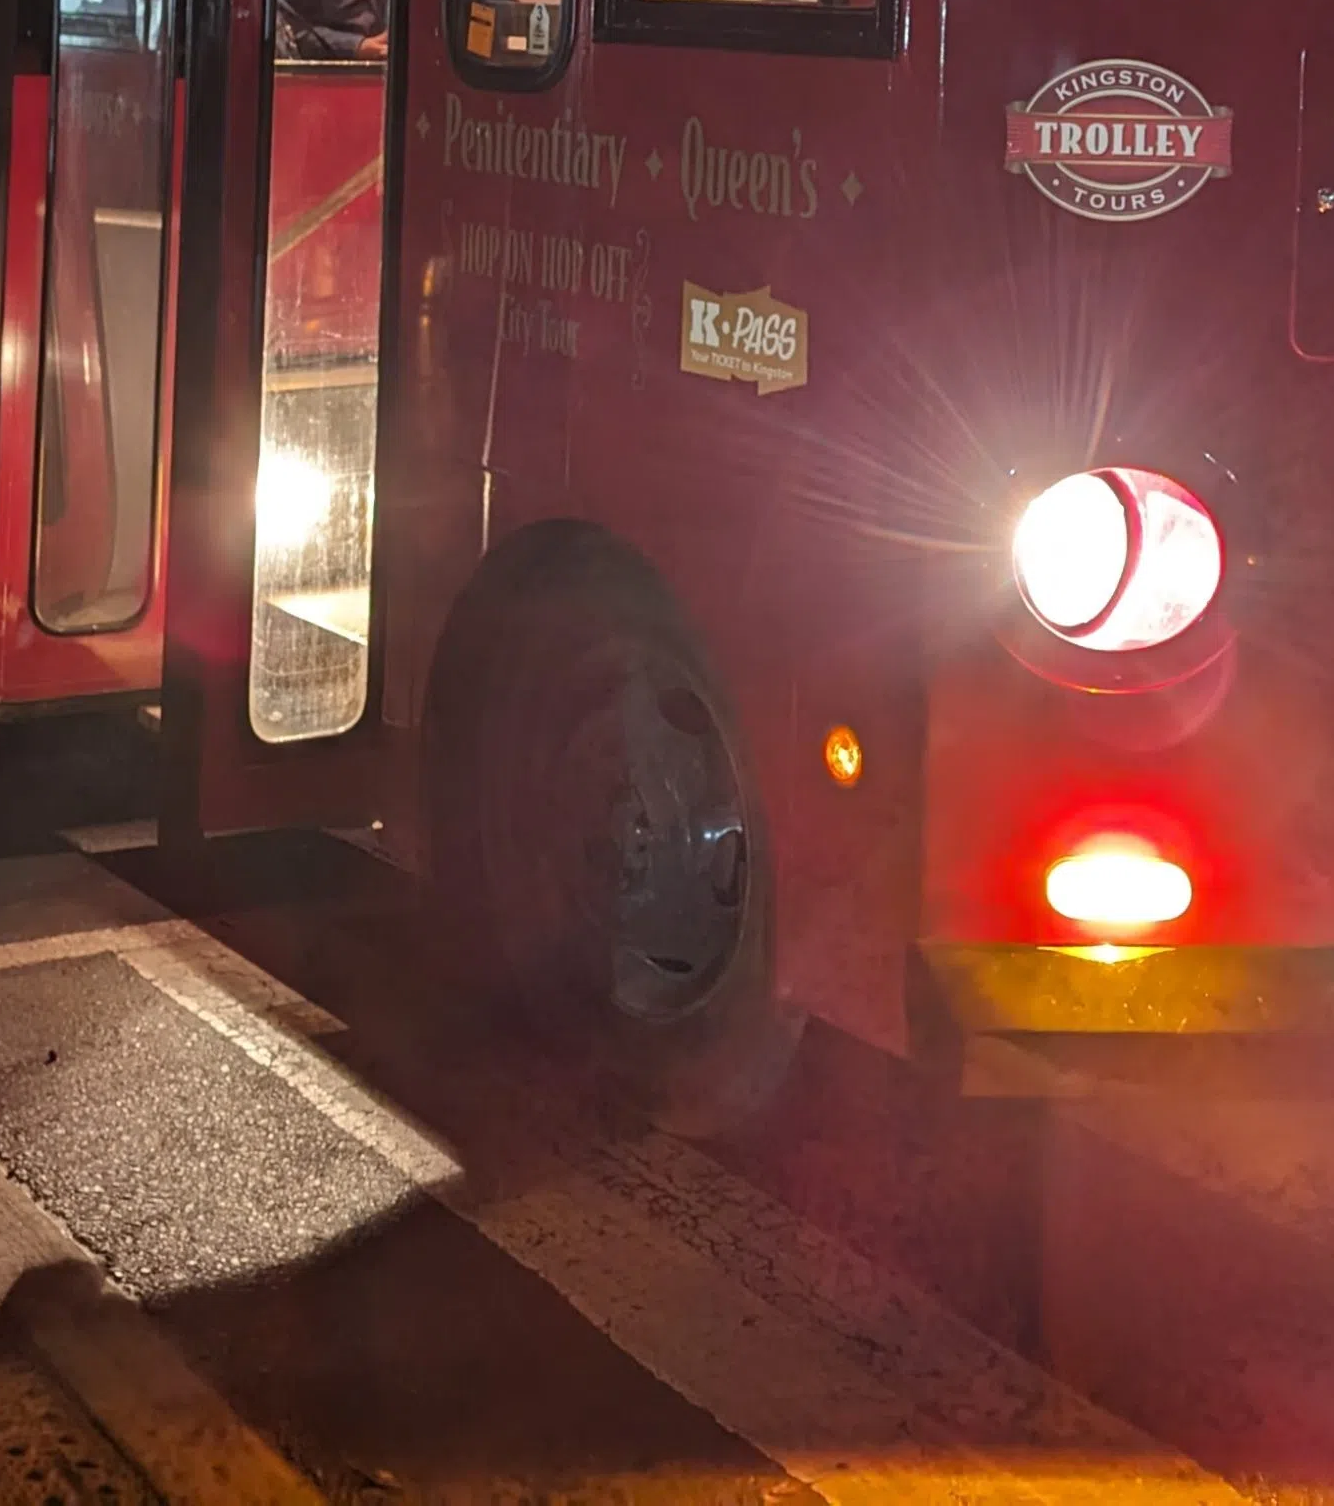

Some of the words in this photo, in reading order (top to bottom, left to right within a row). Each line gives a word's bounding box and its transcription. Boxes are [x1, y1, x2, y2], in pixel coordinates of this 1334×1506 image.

[1054, 69, 1186, 104] KINGSTON
[443, 92, 628, 208] Penitentiary
[680, 116, 818, 220] Queen's
[1034, 121, 1203, 158] TROLLEY
[1073, 187, 1166, 212] TOURS
[461, 221, 501, 278] HOP
[502, 229, 535, 286] ON
[541, 234, 584, 295] HOP
[590, 241, 634, 303] OFF
